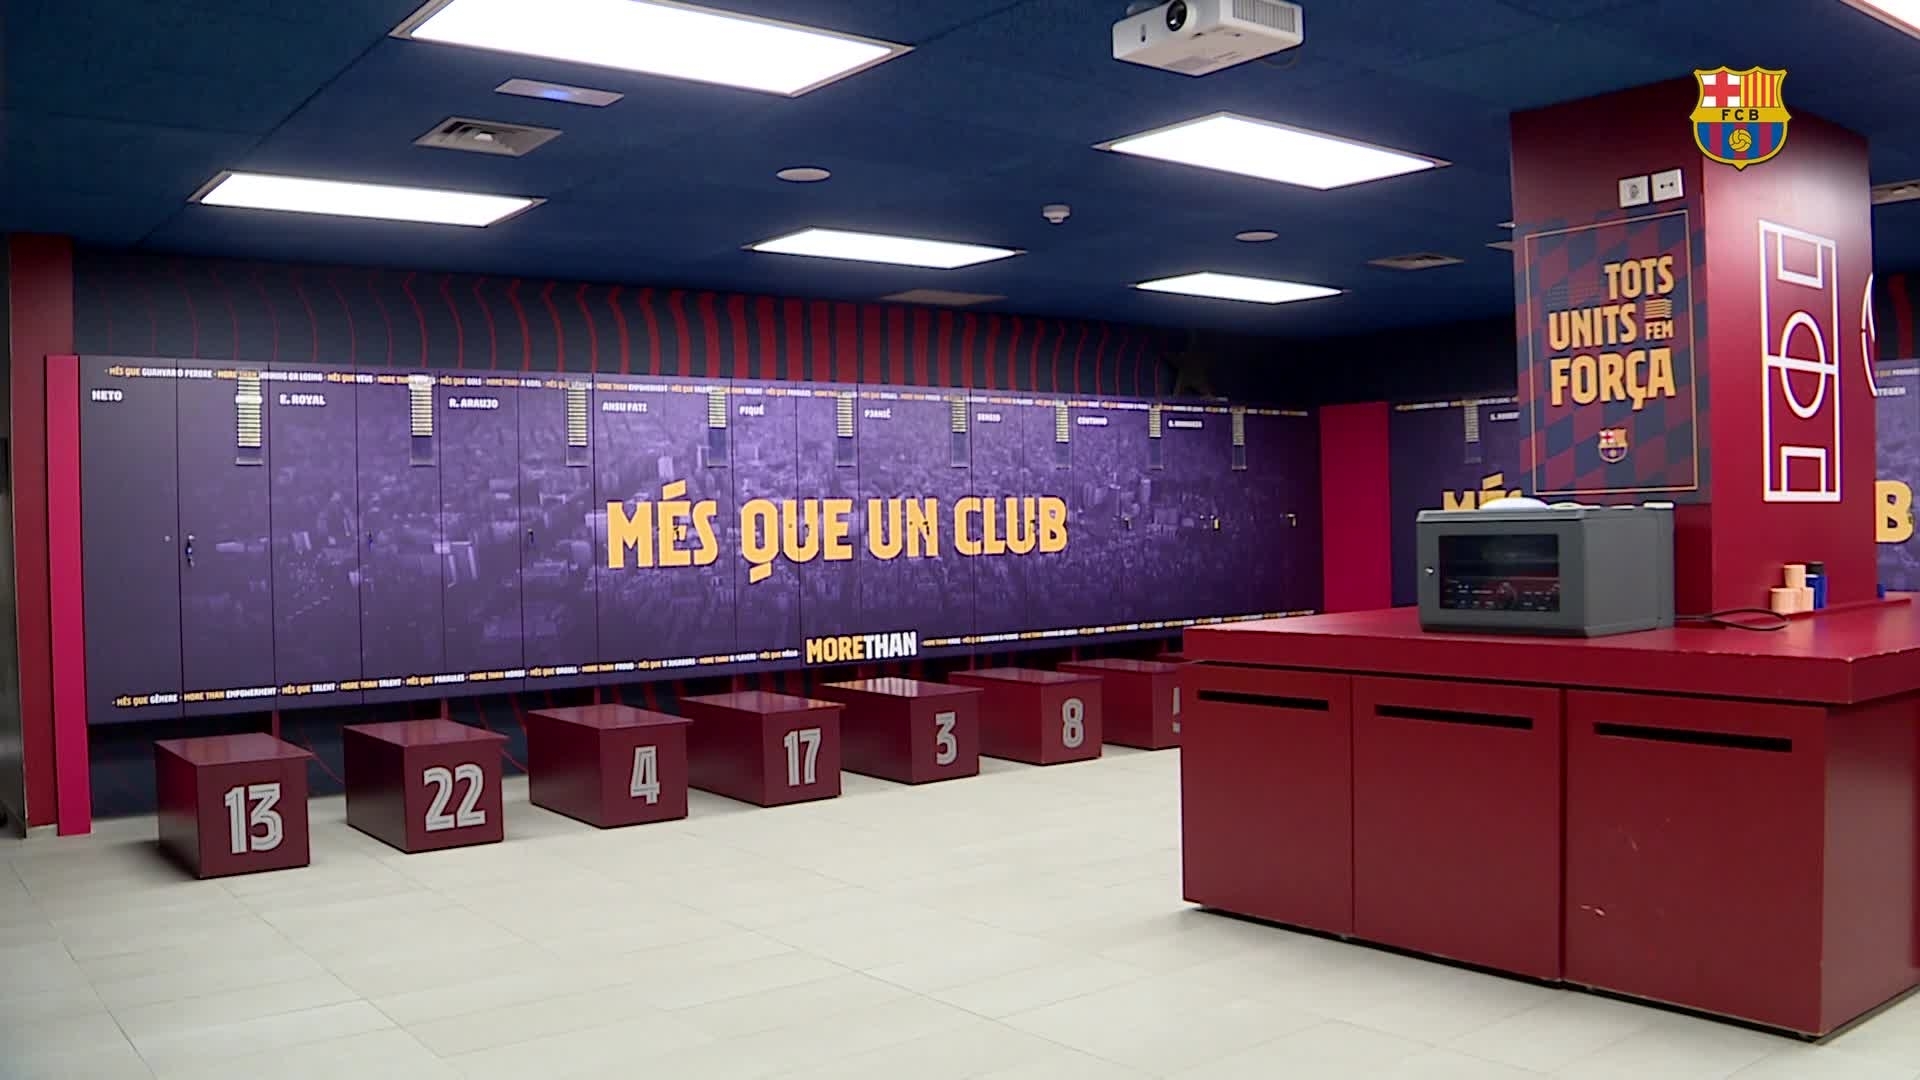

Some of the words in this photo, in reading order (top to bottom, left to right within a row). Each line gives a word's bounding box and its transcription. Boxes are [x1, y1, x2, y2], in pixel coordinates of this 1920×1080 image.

[1605, 255, 1674, 301] TOTS
[1549, 303, 1638, 351] UNITS
[1645, 319, 1673, 341] FEM
[92, 389, 123, 401] NETO
[126, 367, 141, 378] QUE
[1551, 347, 1676, 411] FORÇA
[292, 395, 326, 406] ROYAL
[449, 398, 459, 408] R.
[460, 398, 498, 409] ARAUJO
[602, 402, 626, 412] ANSU
[627, 403, 648, 413] FATI
[739, 403, 764, 417] PIQUÉ
[607, 480, 718, 569] MÉS
[741, 499, 853, 584] QUE
[868, 498, 939, 560] UN
[954, 496, 1068, 556] CLUB
[806, 631, 917, 664] MORETHAN
[117, 695, 132, 706] MÉS
[133, 696, 149, 707] QUE
[184, 692, 204, 702] MORE
[206, 691, 224, 700] THAN
[226, 687, 276, 700] EMPOWERMENT
[297, 684, 311, 695] QUE
[312, 682, 336, 692] TALENT
[341, 681, 359, 690] MORE
[361, 680, 378, 689] THAN
[379, 678, 402, 688] TALENT
[936, 711, 958, 766] 3
[1062, 698, 1083, 748] 8
[630, 745, 661, 804] 4
[784, 728, 821, 787] 17
[225, 782, 284, 854] 13
[423, 764, 487, 832] 22
